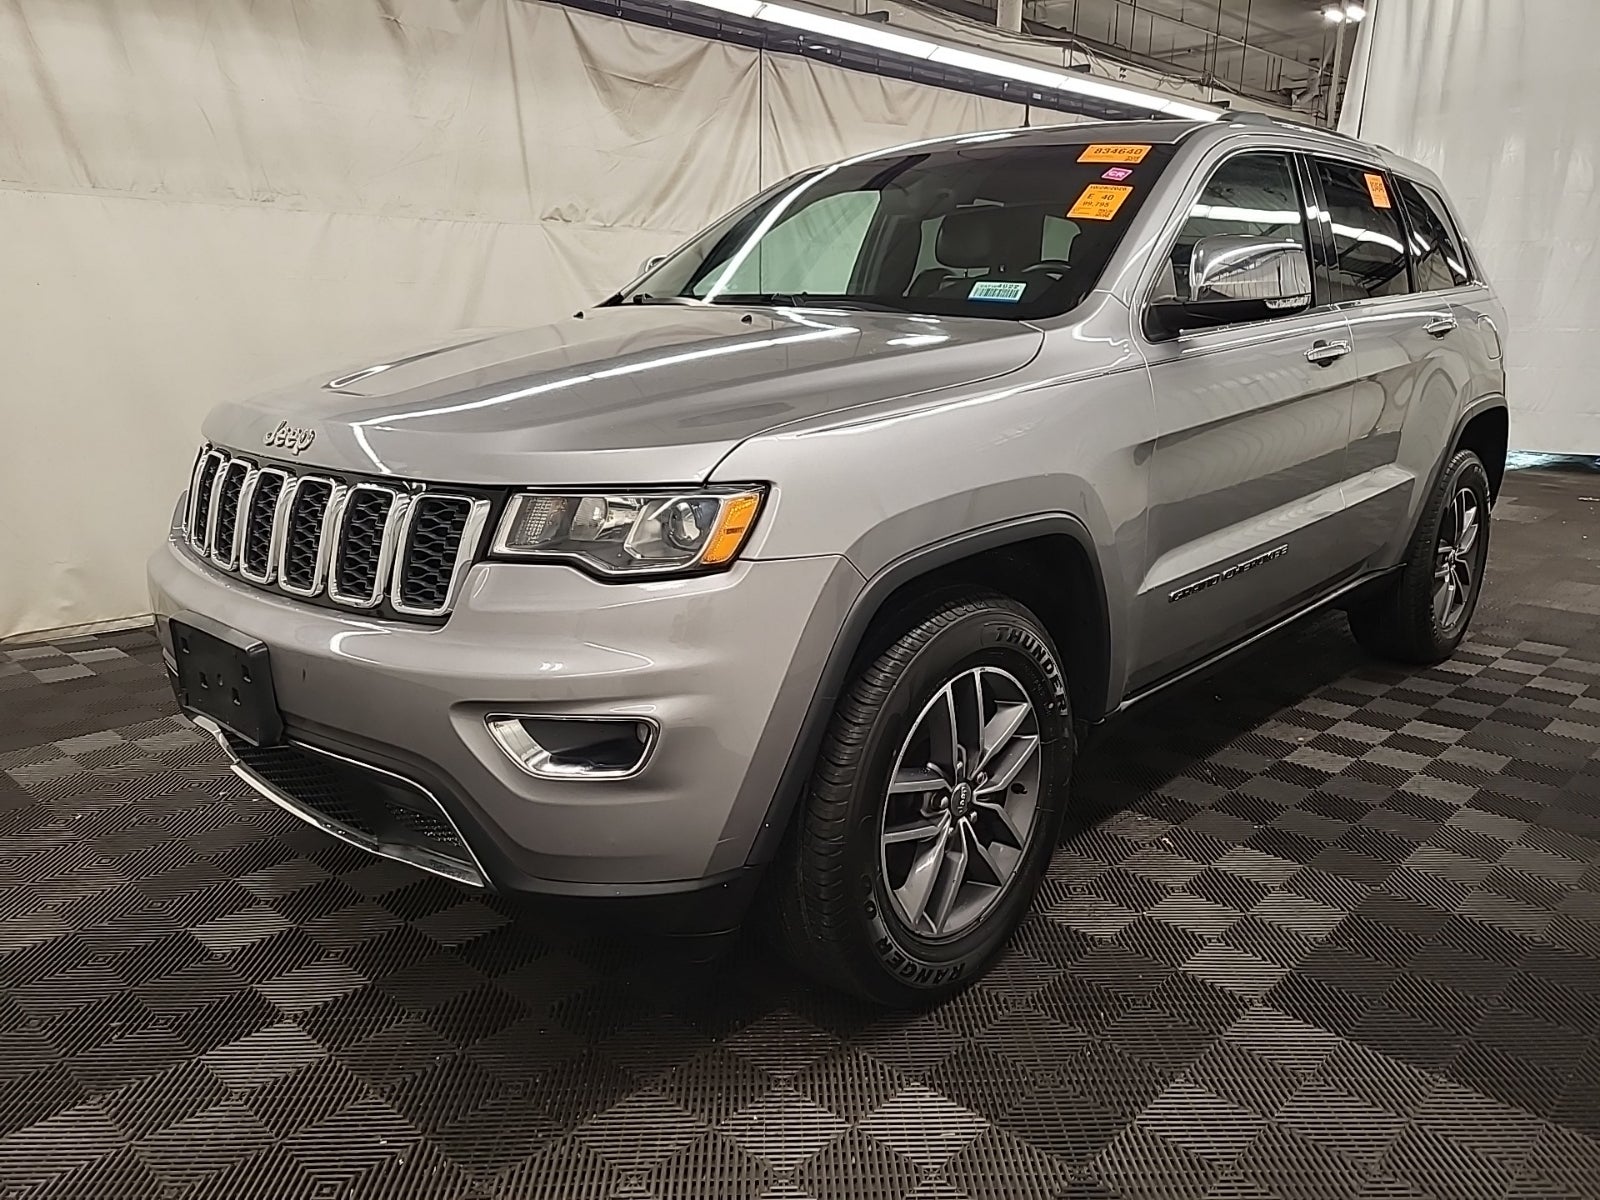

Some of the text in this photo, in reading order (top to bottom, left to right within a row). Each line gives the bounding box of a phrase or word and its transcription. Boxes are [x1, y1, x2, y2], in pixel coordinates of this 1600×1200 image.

[1107, 170, 1126, 178] CR
[263, 420, 316, 457] Jeep
[1168, 543, 1289, 603] GRAND CHEROKEE
[995, 626, 1068, 712] THUNDER
[875, 935, 966, 984] RANGER
